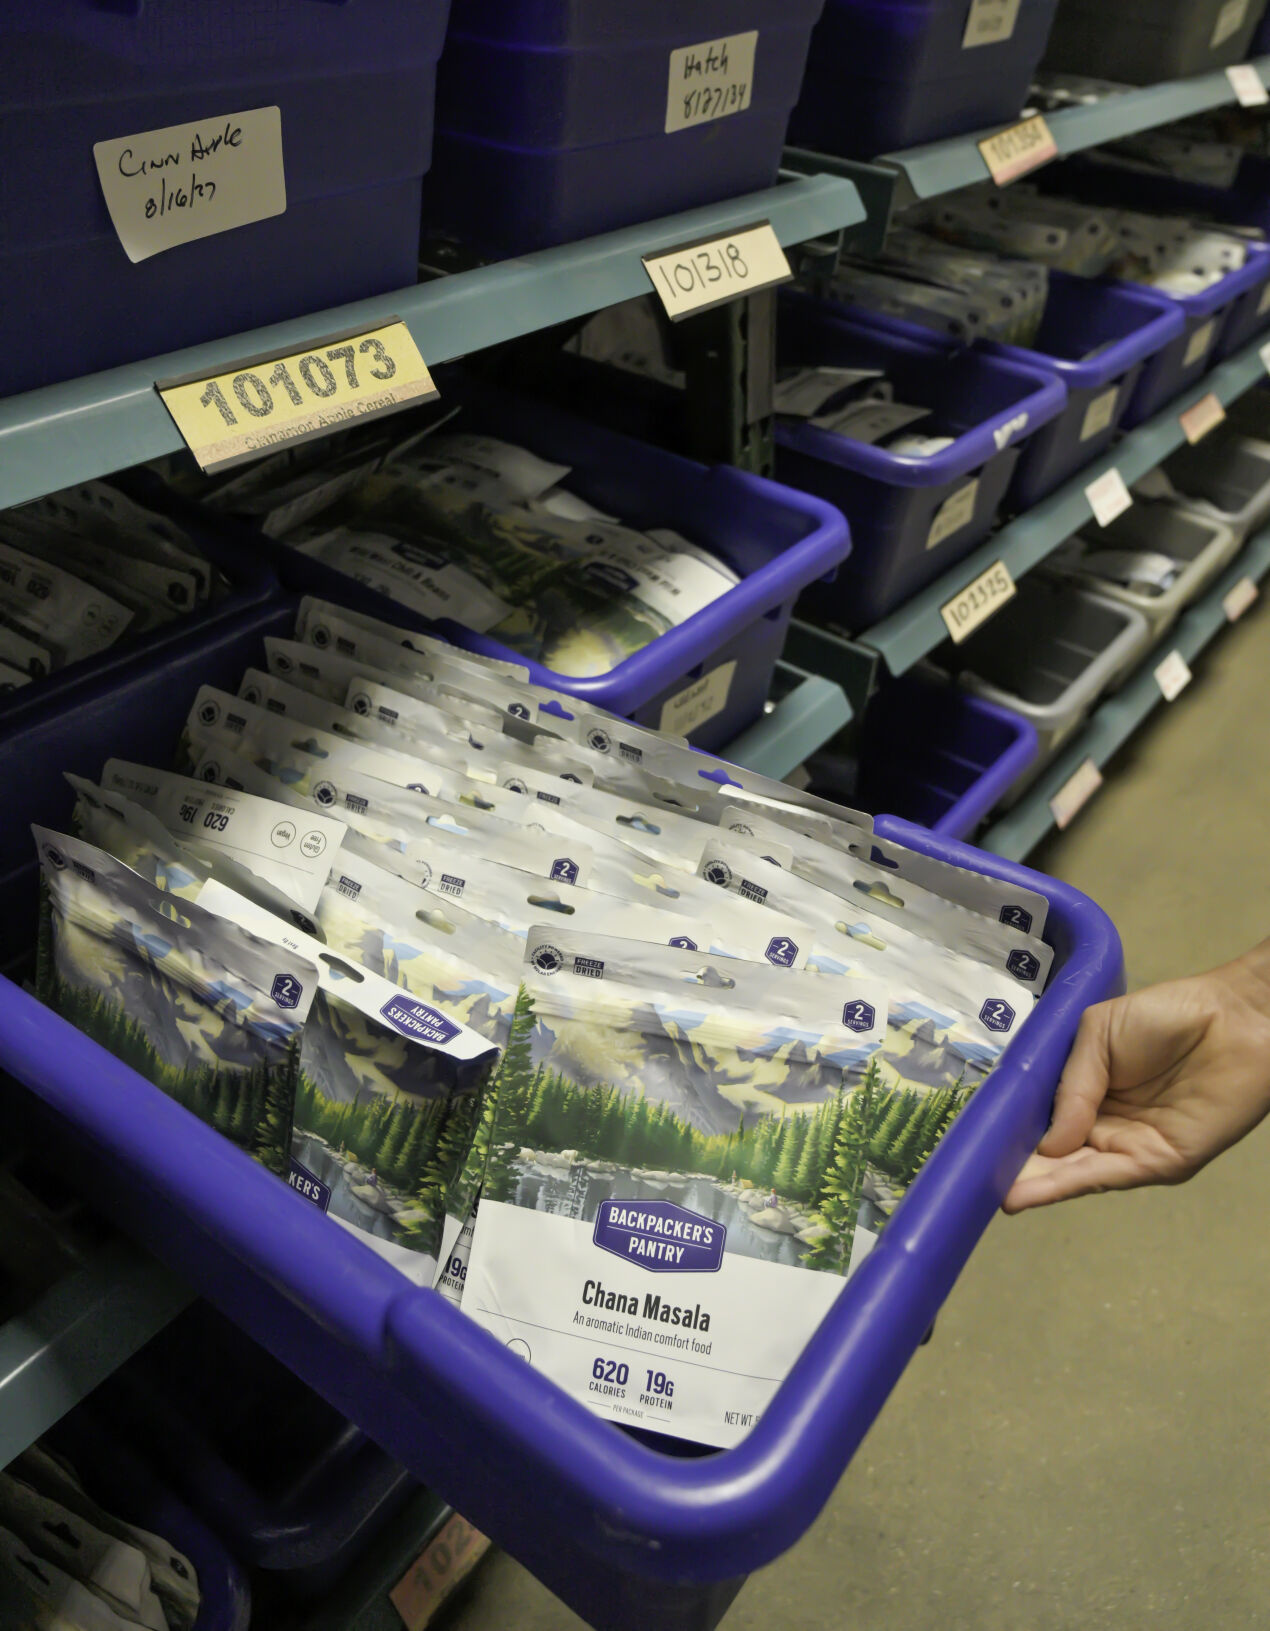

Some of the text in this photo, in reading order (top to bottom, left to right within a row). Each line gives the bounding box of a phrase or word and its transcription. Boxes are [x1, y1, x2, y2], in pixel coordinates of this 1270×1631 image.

[684, 43, 729, 79] Hatch
[659, 243, 748, 298] 101318
[200, 338, 397, 426] 101073
[356, 392, 397, 414] Cereal
[203, 811, 229, 832] 620
[560, 862, 570, 876] 2
[338, 885, 357, 899] DRIED
[440, 883, 462, 895] DRIED
[740, 888, 763, 904] DRIED
[1011, 909, 1021, 924] 2
[777, 941, 789, 957] 2
[576, 958, 602, 968] FREEZE
[1019, 954, 1030, 970] 2
[575, 966, 601, 977] DRIED
[281, 978, 293, 996] 2
[410, 1005, 444, 1027] PANTRY
[854, 1004, 865, 1020] 2
[992, 1003, 1005, 1020] 2
[608, 1206, 714, 1244] BACKPACKER'S
[628, 1236, 685, 1264] PANTRY
[582, 1279, 711, 1332] Chana Masala
[572, 1310, 713, 1356] An aromatic Indian comfort food
[592, 1357, 630, 1386] 620
[588, 1381, 673, 1411] CALORIES PROTEIN
[612, 1404, 644, 1419] PER PACKAGE
[724, 1411, 740, 1426] NET
[741, 1413, 753, 1427] WT
[413, 1521, 474, 1592] 102
